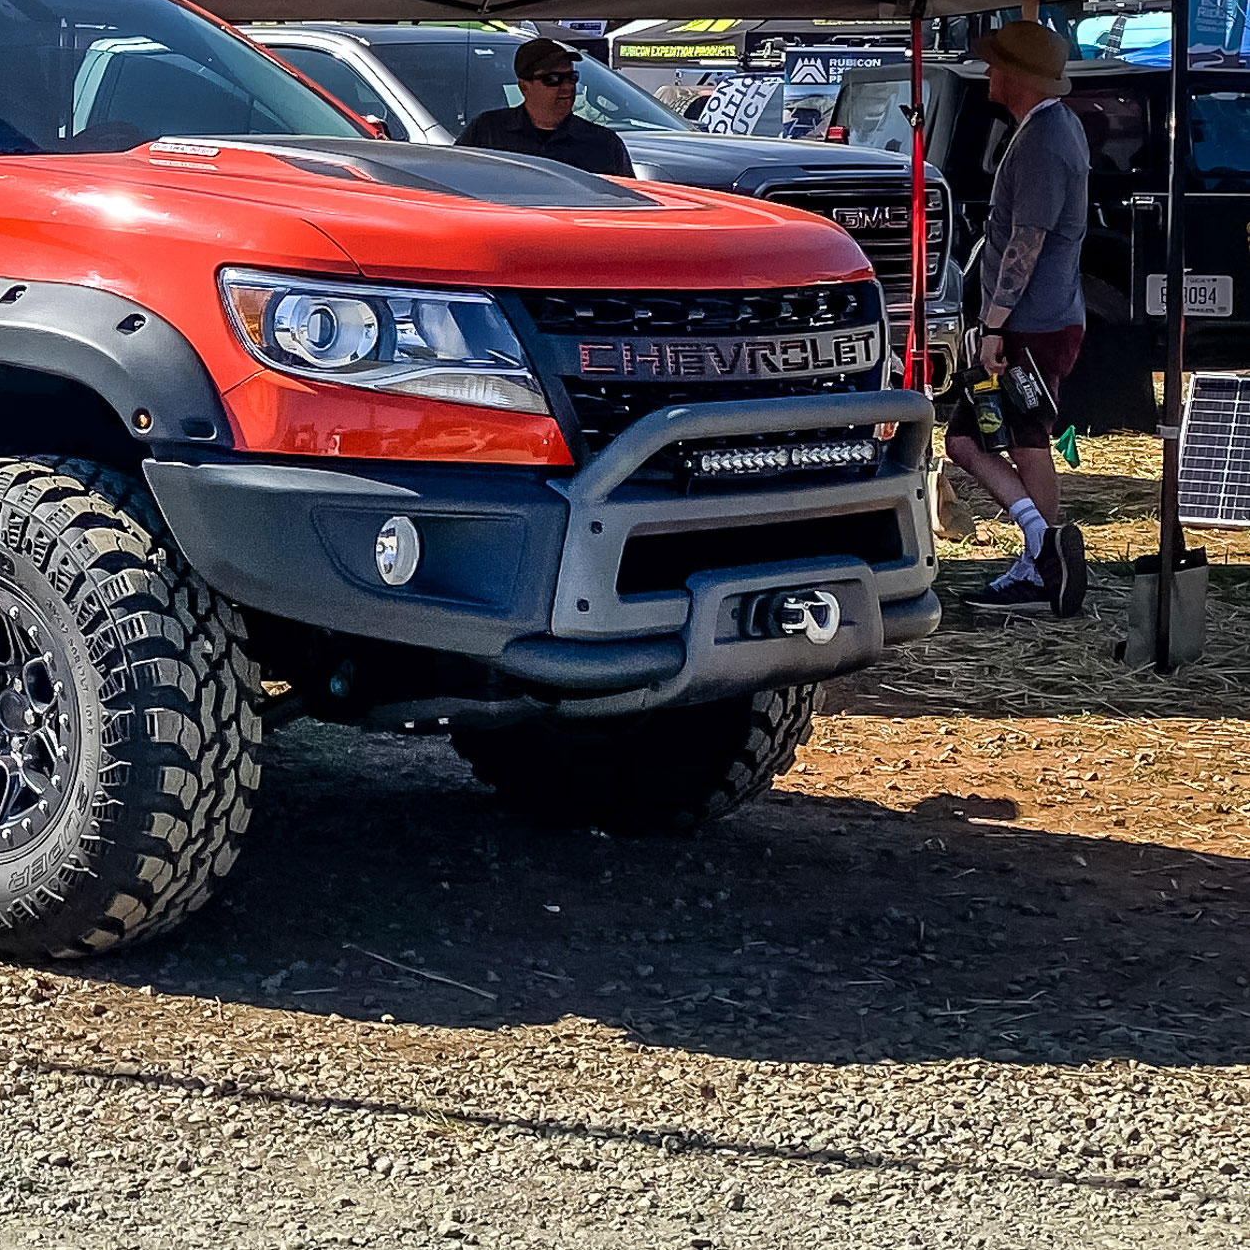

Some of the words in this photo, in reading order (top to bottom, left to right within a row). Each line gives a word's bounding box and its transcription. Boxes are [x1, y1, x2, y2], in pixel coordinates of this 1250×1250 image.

[619, 45, 650, 57] RUBICON
[651, 45, 694, 57] EXPEDITION
[694, 45, 737, 57] PRODUCTS
[829, 58, 882, 67] RUBICON
[832, 207, 908, 229] GMC
[578, 330, 876, 376] CHEVROLET
